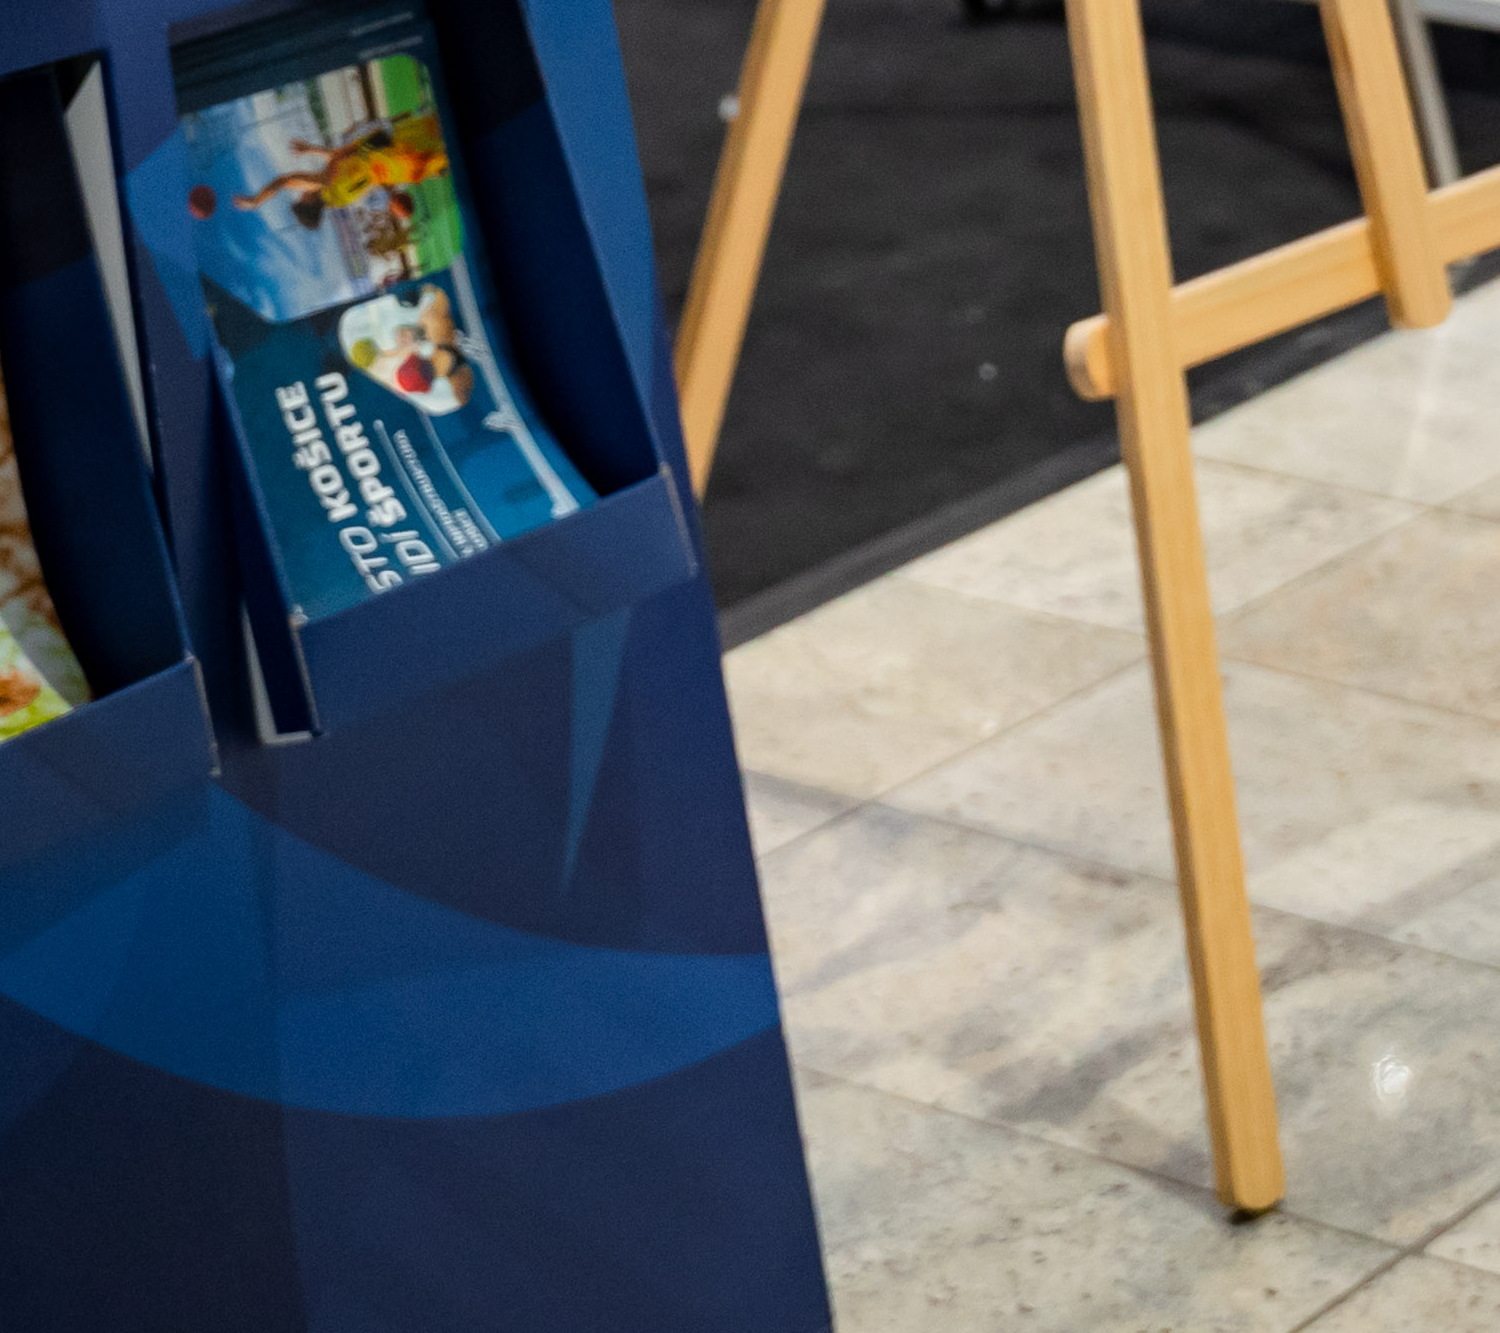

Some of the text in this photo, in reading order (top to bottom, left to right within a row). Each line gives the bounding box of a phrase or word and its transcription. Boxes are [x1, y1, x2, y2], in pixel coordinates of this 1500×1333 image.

[276, 379, 404, 595] STO KOŠICE
[314, 372, 407, 530] ŠPORTU
